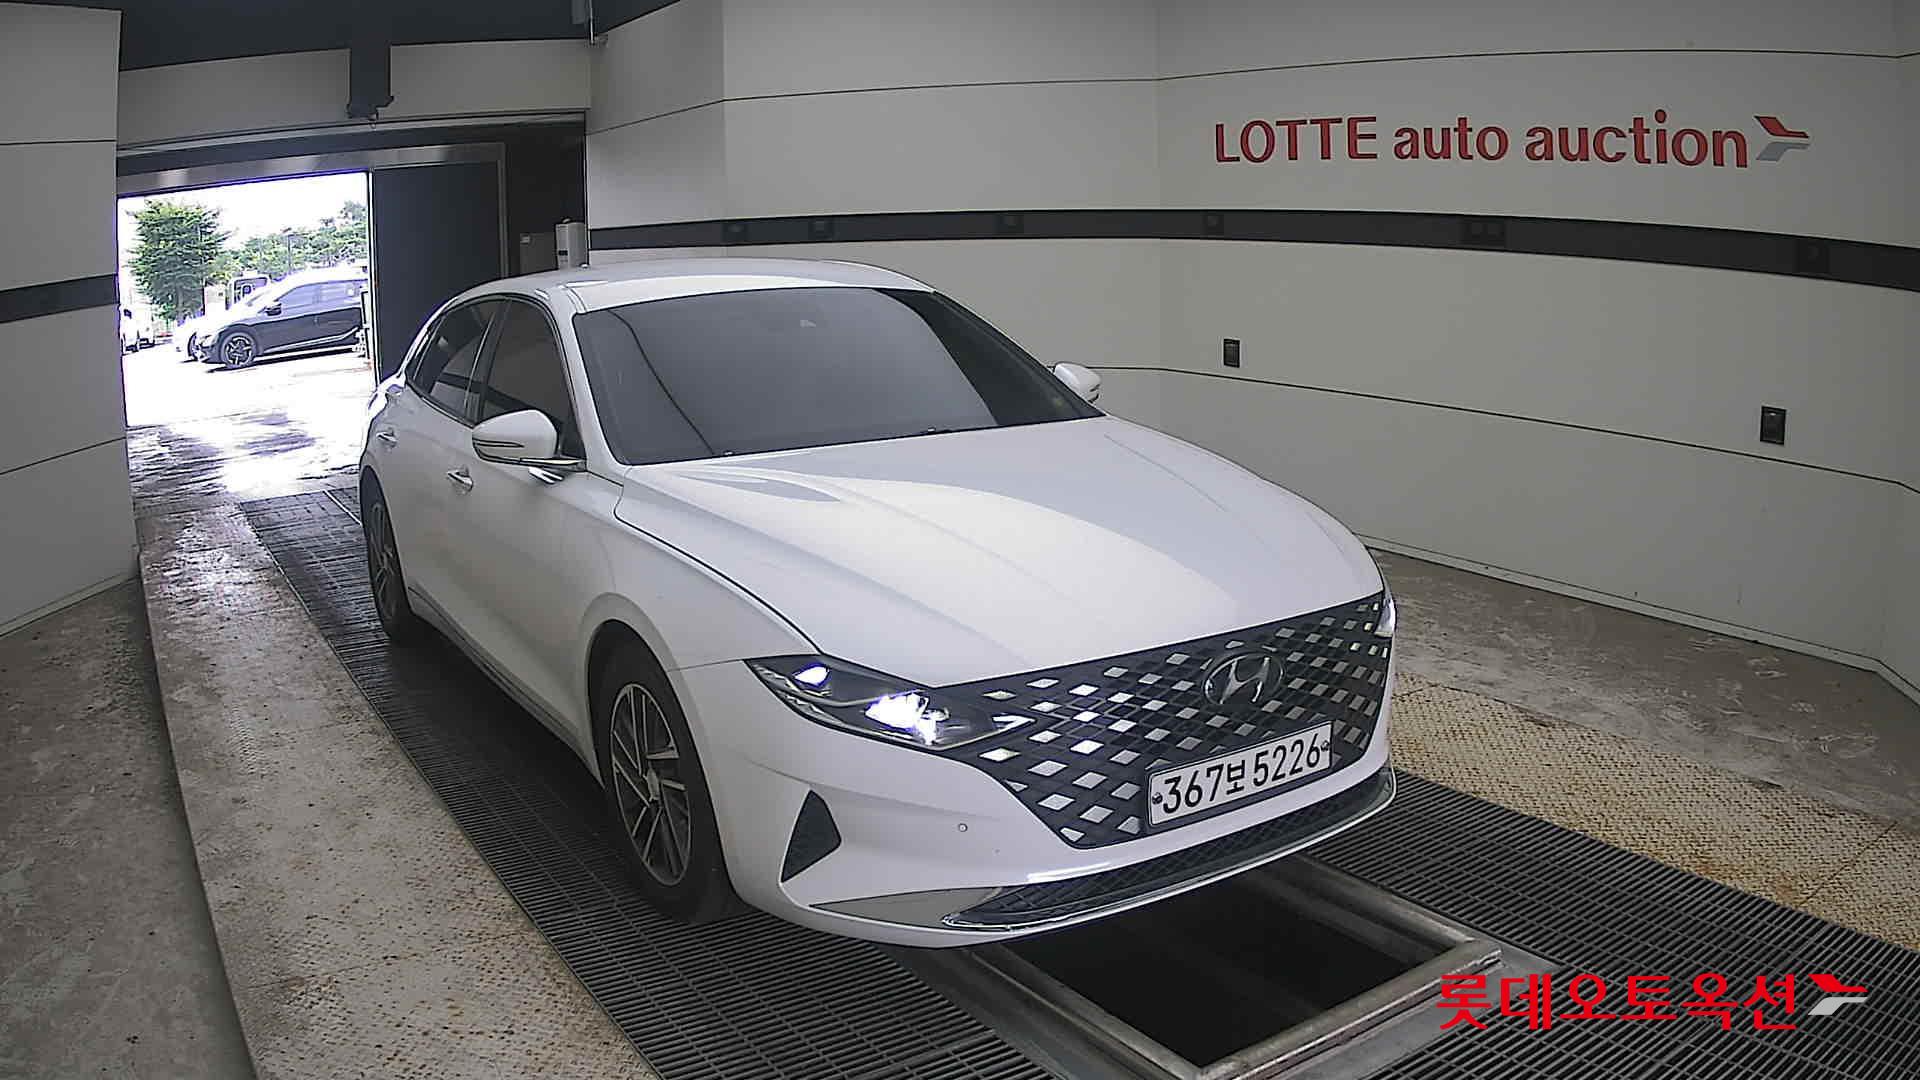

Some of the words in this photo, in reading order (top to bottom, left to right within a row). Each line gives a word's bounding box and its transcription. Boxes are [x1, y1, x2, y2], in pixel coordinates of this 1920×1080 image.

[1215, 116, 1377, 163] LOTTE
[1393, 116, 1509, 161] auto
[1525, 109, 1748, 168] auction
[1163, 760, 1246, 814] 367보
[1252, 733, 1321, 787] 5226
